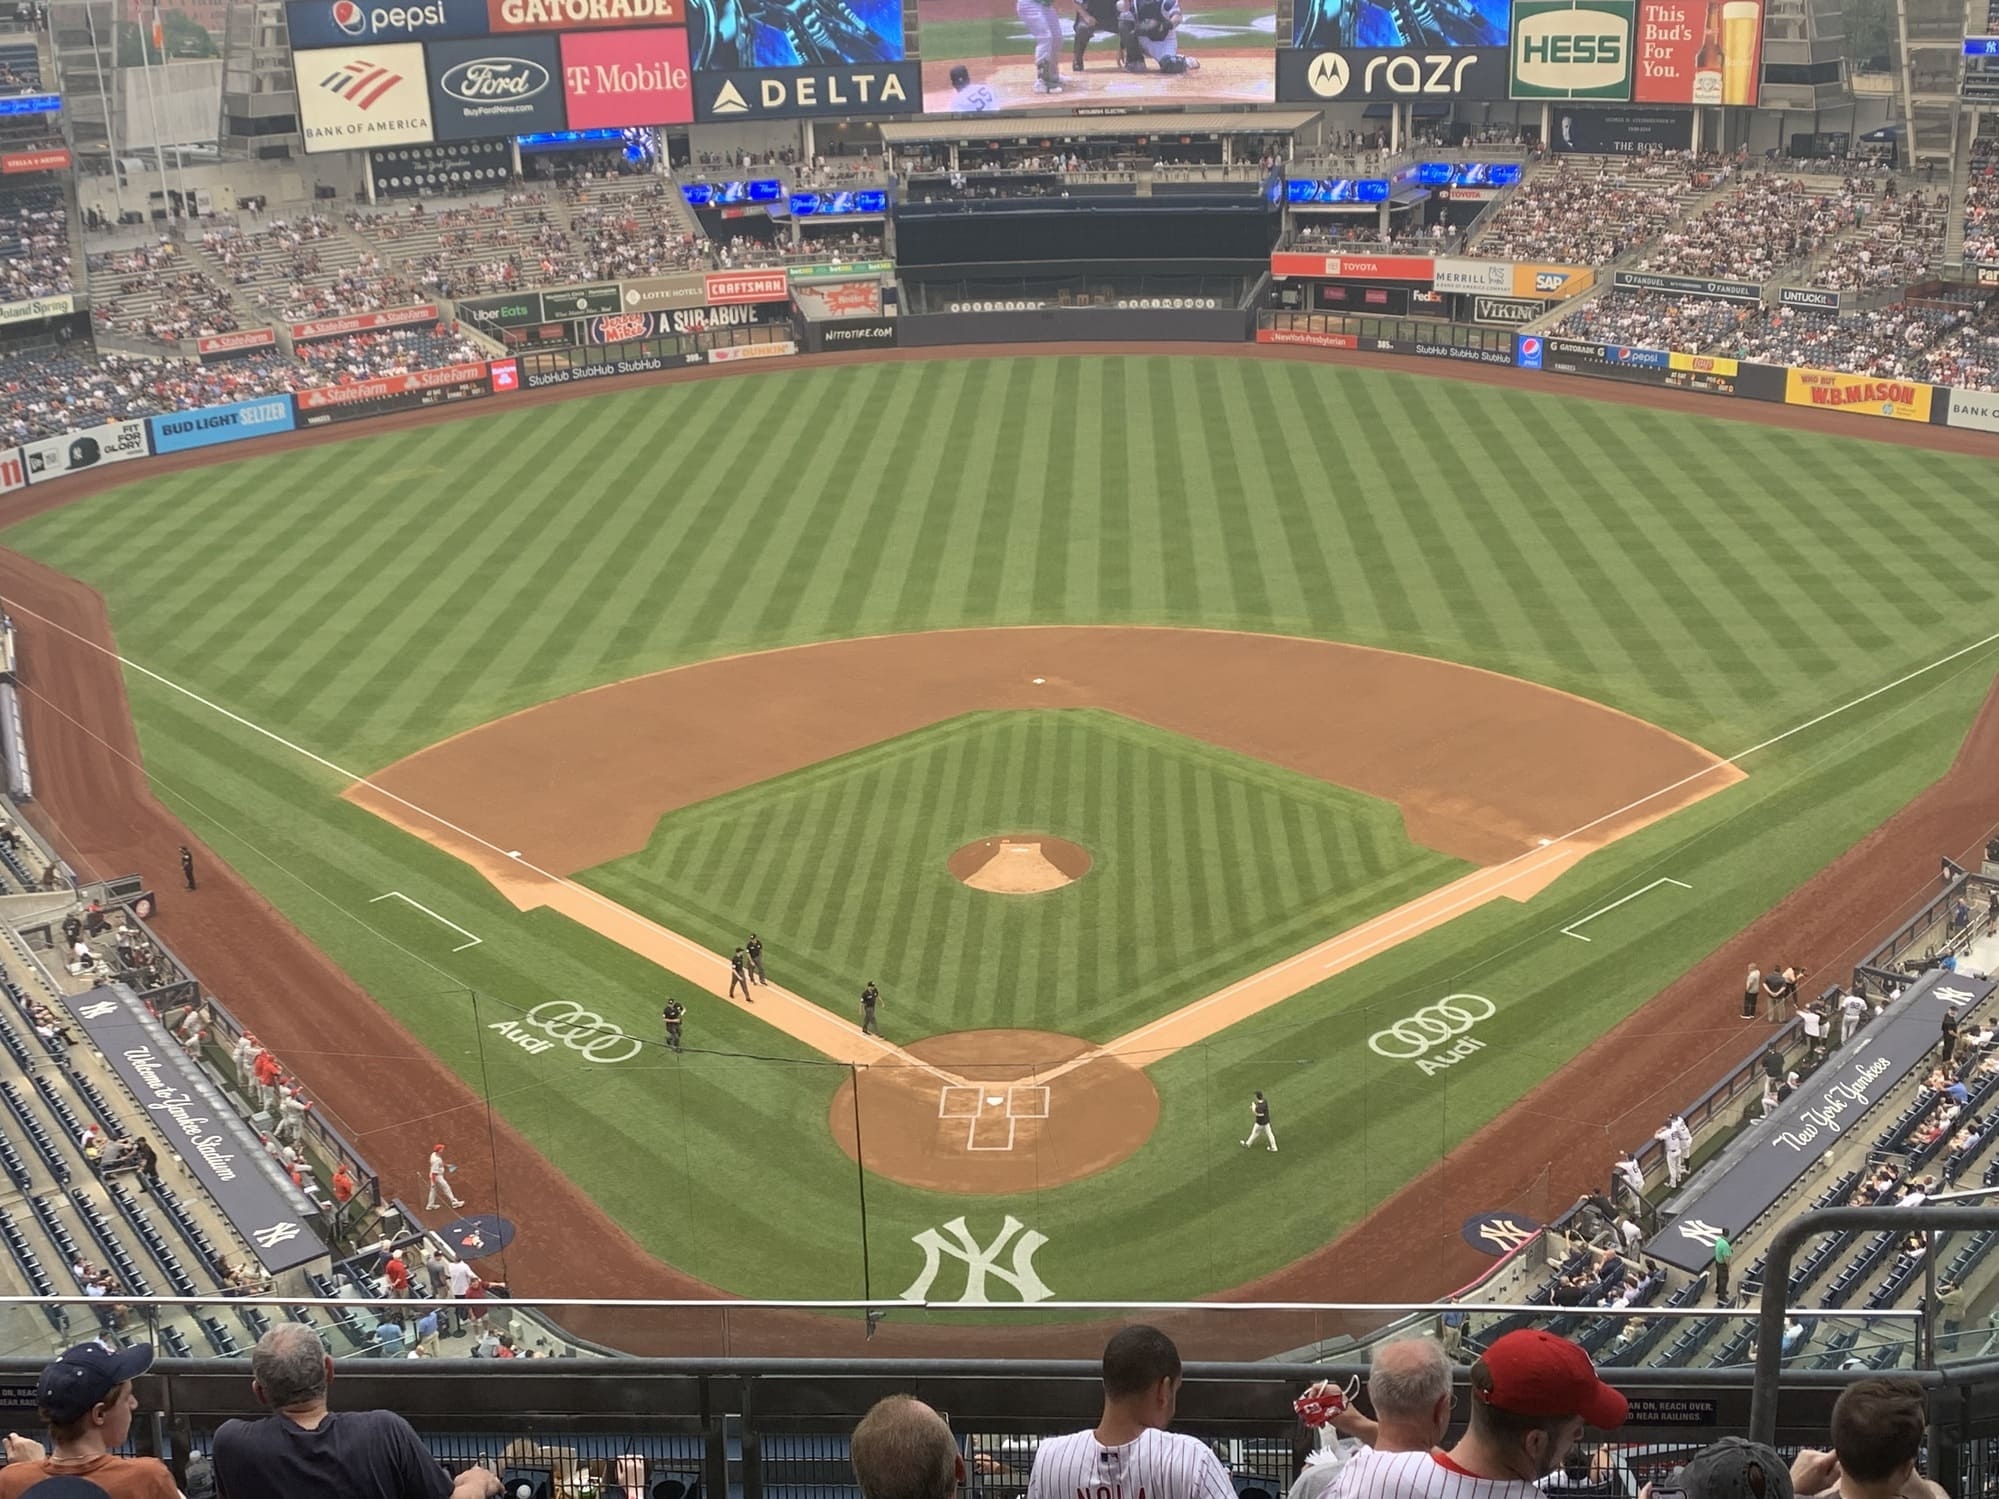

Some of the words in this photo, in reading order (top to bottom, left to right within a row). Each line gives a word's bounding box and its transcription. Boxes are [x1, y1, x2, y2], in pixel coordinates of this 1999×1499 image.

[371, 1, 446, 34] pepsi
[501, 0, 673, 24] GATORADE
[1645, 5, 1685, 22] This
[1645, 24, 1693, 41] Bud's
[1523, 35, 1622, 63] HESS
[1643, 43, 1674, 59] For
[1364, 55, 1478, 93] razr
[1642, 60, 1681, 78] You.
[461, 63, 530, 96] Ford
[567, 66, 591, 95] T
[597, 62, 688, 93] Mobile
[760, 73, 907, 108] DELTA
[463, 104, 534, 117] BuyFordNow.com
[306, 125, 344, 138] BANK
[346, 122, 364, 135] OF
[367, 118, 428, 133] AMERICA
[1614, 141, 1634, 151] THE
[1451, 190, 1481, 199] TOYOTA
[1343, 263, 1378, 271] TOYOTA
[1436, 272, 1486, 284] MERRILL
[1536, 275, 1563, 290] SAP
[1633, 275, 1664, 286] FANDUEL
[642, 291, 672, 300] LOTTE
[673, 288, 703, 297] HOTELS
[711, 279, 782, 295] CRAFTSMAN
[1716, 284, 1750, 295] FANDUEL
[1413, 290, 1443, 302] FedEx
[1784, 291, 1827, 304] UNTUCKit
[33, 301, 68, 318] Spring
[473, 307, 500, 321] Uber
[501, 305, 528, 317] Eats
[1479, 300, 1540, 321] VIKING
[600, 312, 646, 329] Jersey
[659, 313, 671, 333] A
[709, 304, 758, 326] ABOVE
[825, 326, 893, 342] NITTOTIRE.COM
[1416, 344, 1448, 356] StubHub
[1450, 347, 1479, 360] StubHub
[1481, 352, 1511, 364] StubHub
[1560, 343, 1595, 355] GATORADE
[1632, 352, 1658, 364] pepsi
[529, 371, 570, 387] StubHub
[572, 364, 615, 380] StubHub
[618, 357, 662, 373] StubHub
[162, 424, 193, 436] BUD
[196, 412, 239, 432] LIGHT
[239, 402, 287, 426] SELTZER
[1953, 404, 1988, 417] BANK
[1992, 409, 1999, 418] O
[123, 424, 139, 434] FIT
[118, 433, 141, 444] FOR
[104, 441, 141, 454] GLORY
[488, 1021, 555, 1054] Audi
[1415, 1035, 1487, 1076] Audi
[123, 1045, 165, 1089] Welcome
[154, 1087, 177, 1099] to
[1772, 1124, 1818, 1152] New
[1800, 1093, 1848, 1132] York
[1829, 1057, 1891, 1105] Yankees
[148, 1094, 209, 1135] Yankee
[191, 1135, 236, 1181] Stadium
[17, 1389, 38, 1397] REAC
[1628, 1402, 1641, 1410] AN
[1643, 1402, 1658, 1411] ON,
[1660, 1402, 1687, 1411] REACH
[1636, 1412, 1660, 1420] NEAR
